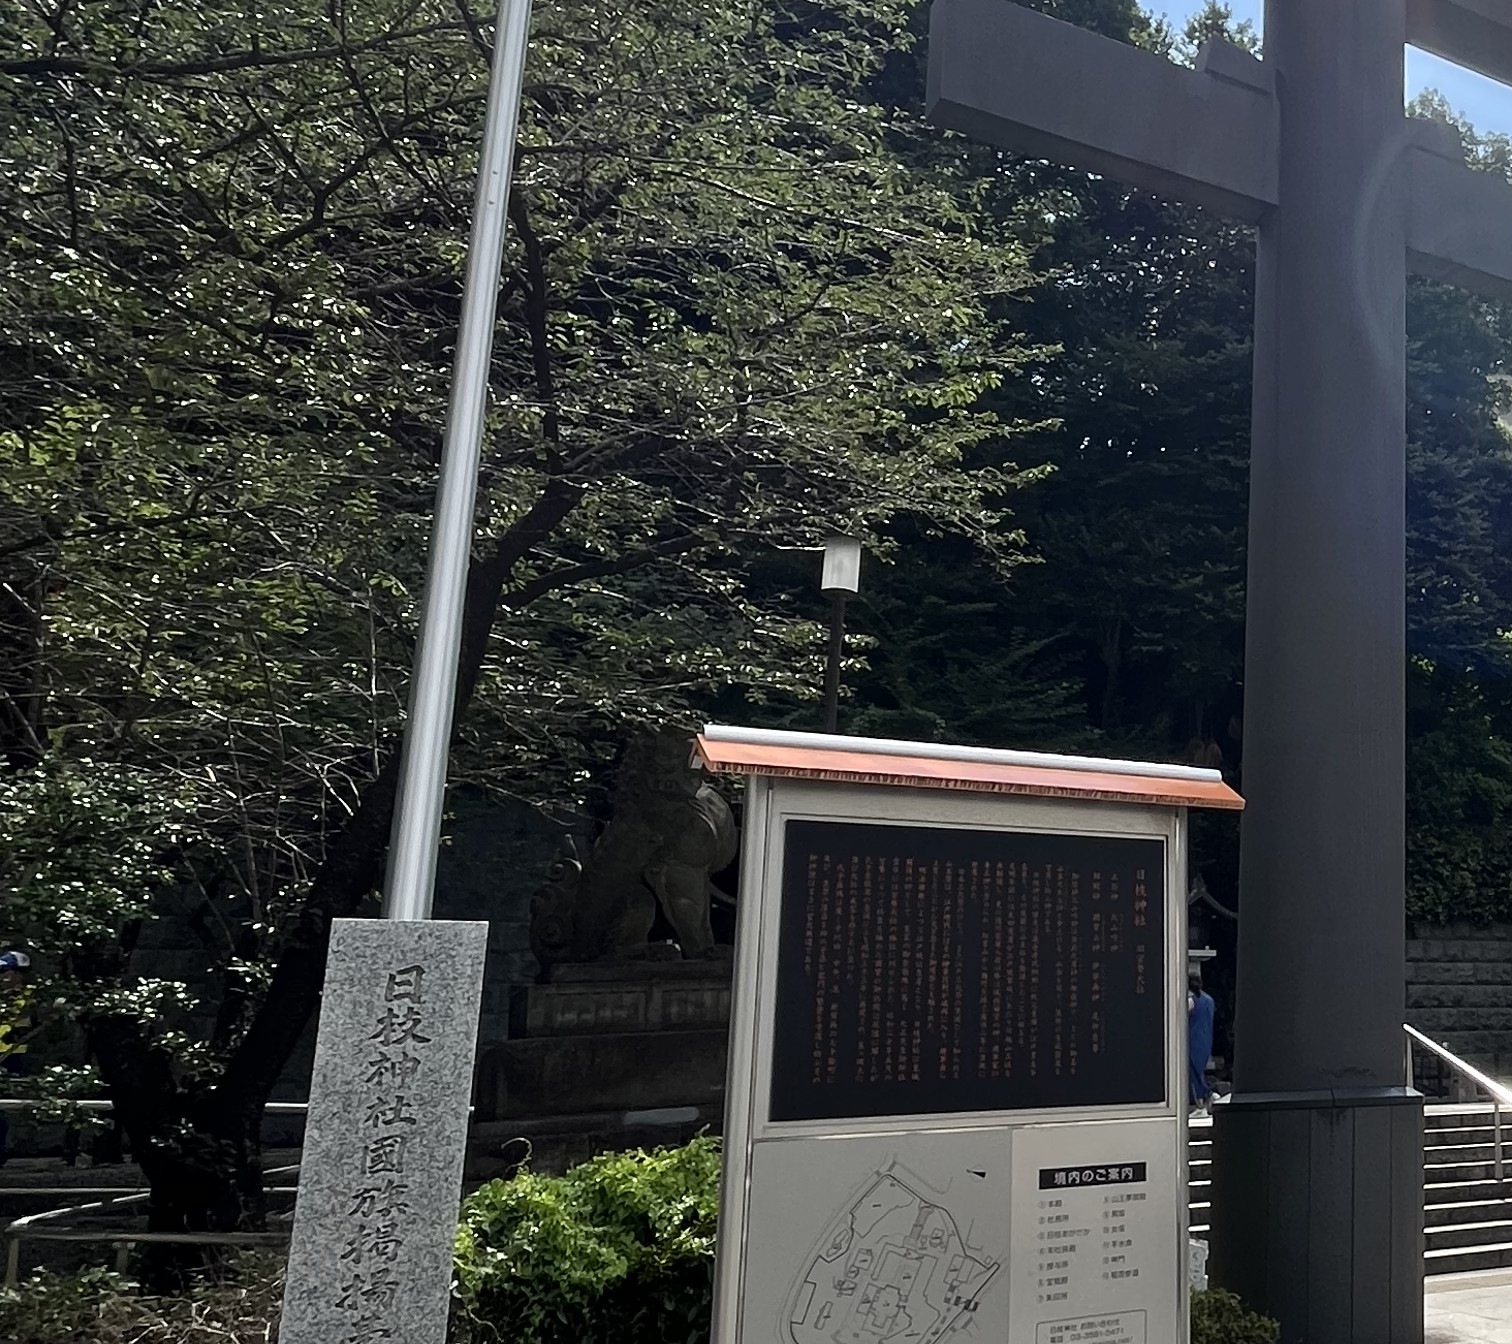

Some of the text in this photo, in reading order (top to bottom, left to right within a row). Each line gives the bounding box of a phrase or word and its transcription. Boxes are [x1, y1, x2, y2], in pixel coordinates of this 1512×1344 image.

[1053, 1167, 1134, 1185] 境内のご案内
